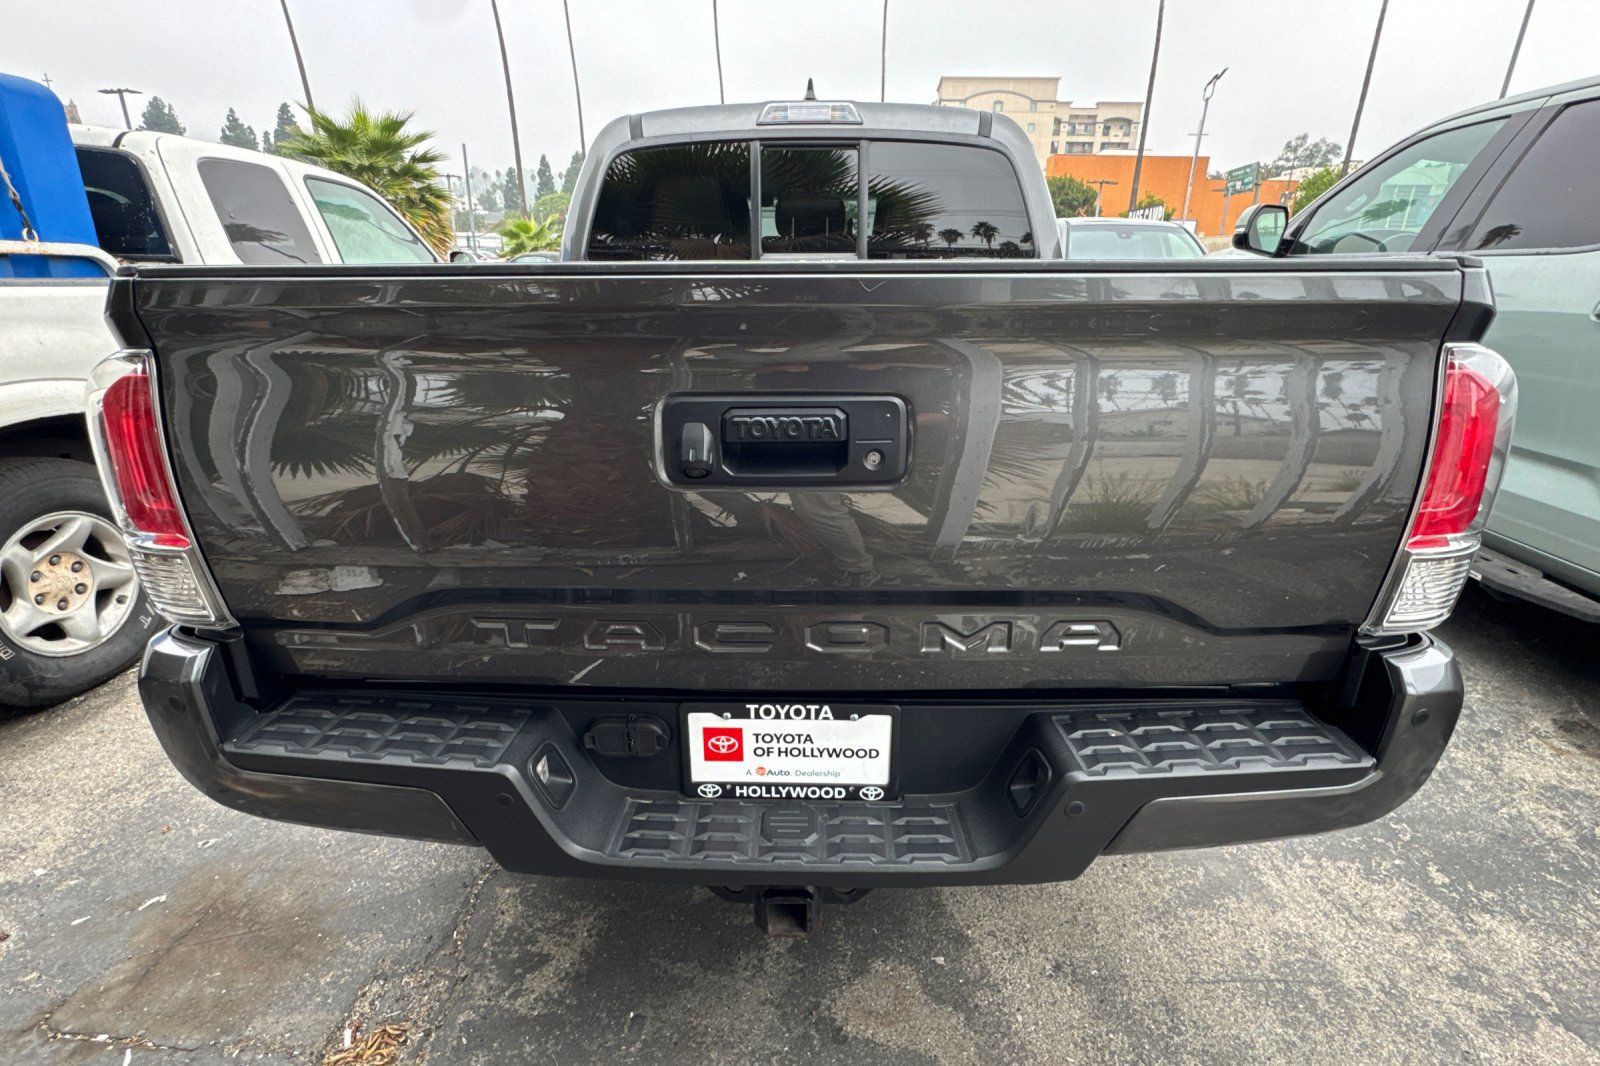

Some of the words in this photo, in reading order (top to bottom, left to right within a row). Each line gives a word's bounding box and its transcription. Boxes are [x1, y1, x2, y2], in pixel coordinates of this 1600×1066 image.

[732, 416, 838, 439] TOYOTA
[470, 616, 1122, 652] TACOMA
[746, 704, 834, 720] TOYOTA
[752, 733, 814, 744] TOYOTA
[753, 747, 777, 758] OF
[777, 747, 880, 759] HOLLYWOOD
[795, 769, 841, 778] Dealership
[735, 785, 846, 799] HOLLYWOOD
